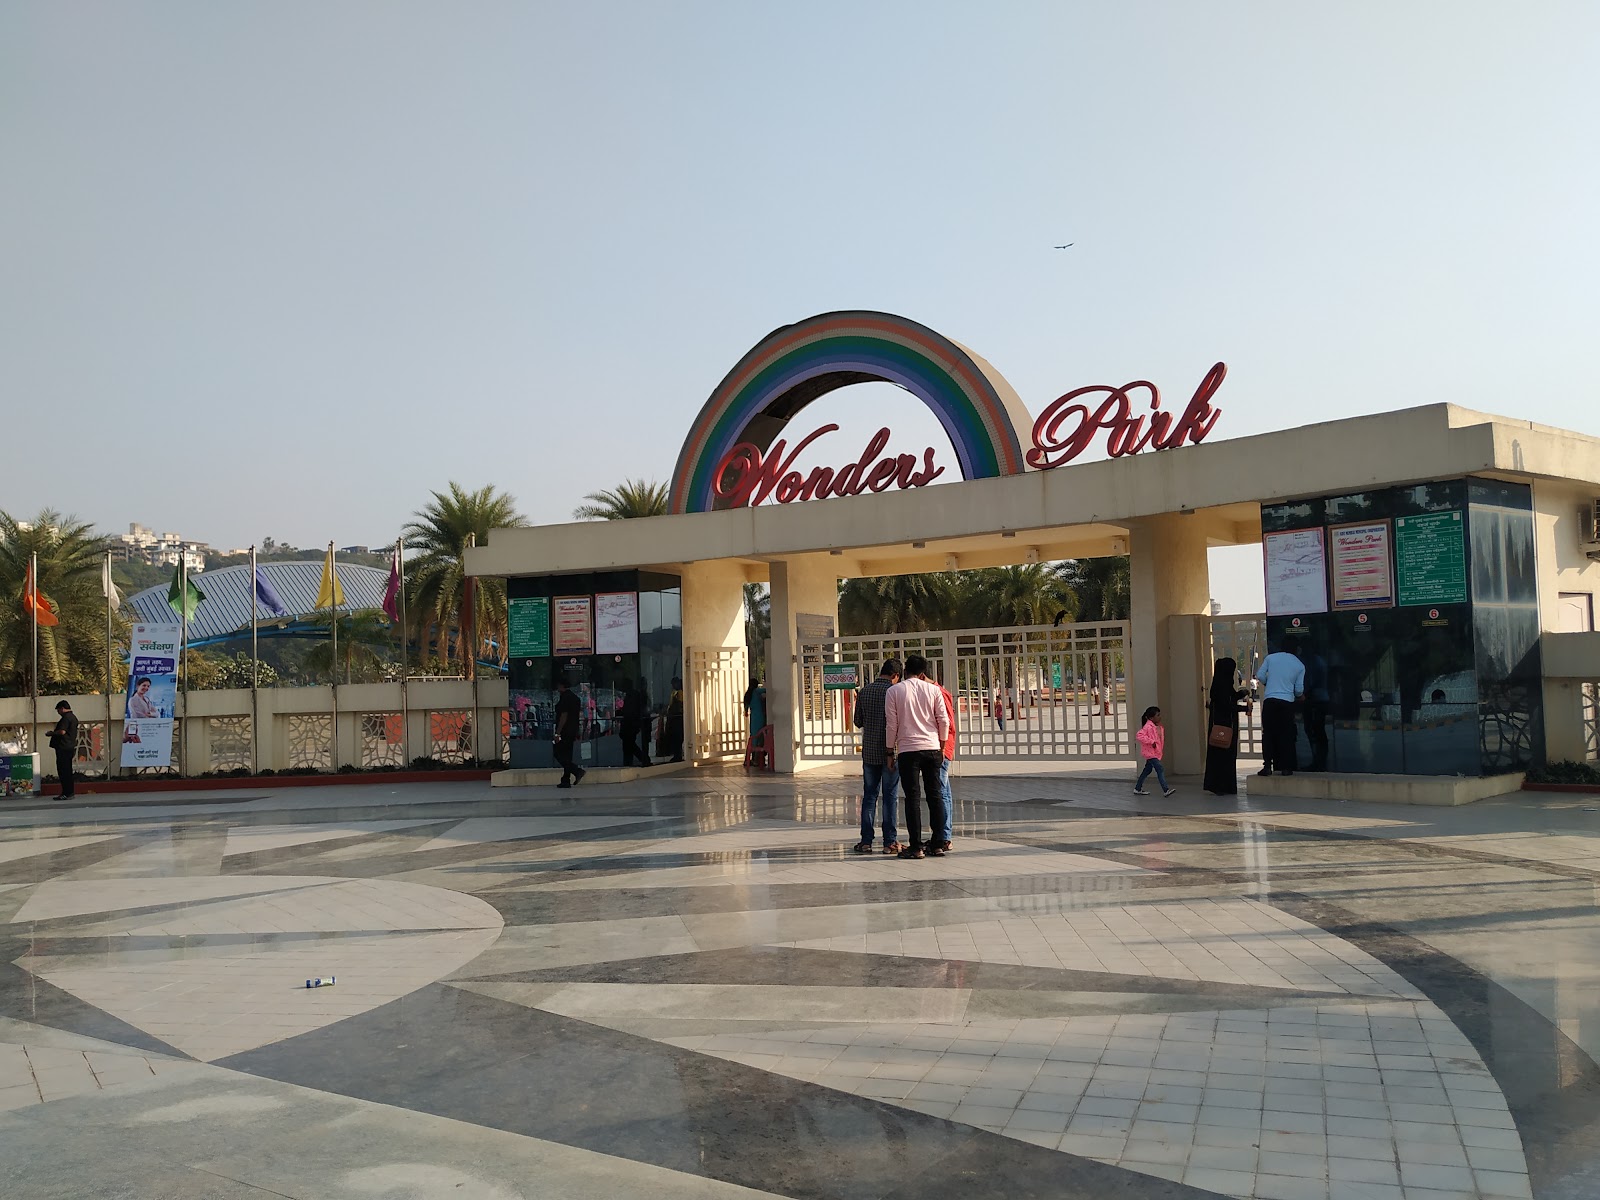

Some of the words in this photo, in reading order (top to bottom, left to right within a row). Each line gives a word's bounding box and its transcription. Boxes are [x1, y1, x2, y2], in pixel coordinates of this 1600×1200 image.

[712, 424, 945, 507] Wonders
[1026, 361, 1228, 469] Park
[140, 640, 174, 651] सर्वेक्षण
[146, 665, 157, 673] मुंबई
